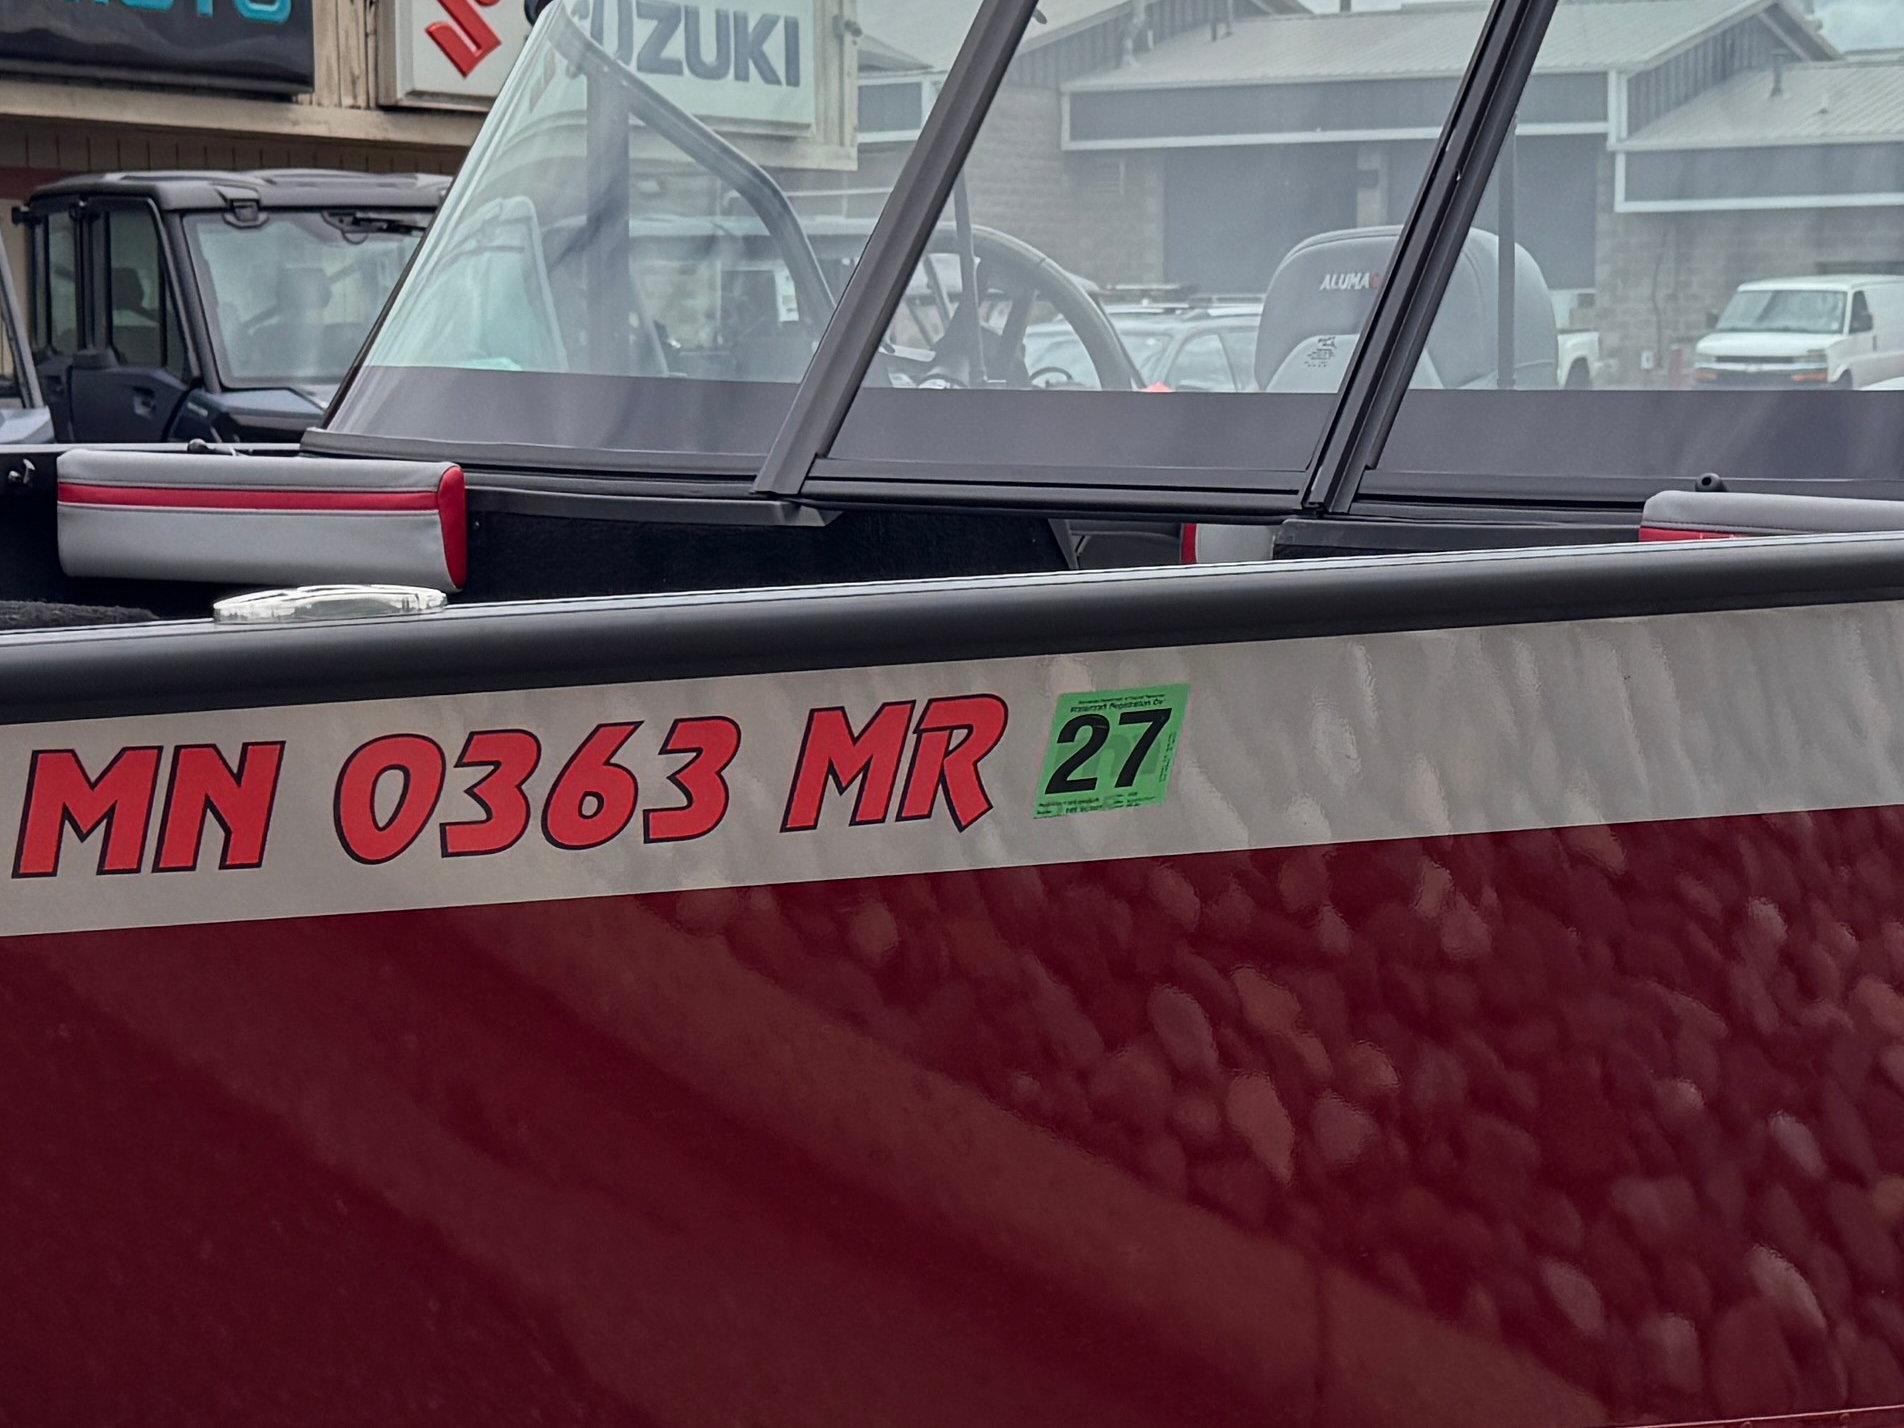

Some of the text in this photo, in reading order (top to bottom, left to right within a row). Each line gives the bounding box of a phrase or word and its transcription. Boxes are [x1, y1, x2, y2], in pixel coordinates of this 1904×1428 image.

[11, 693, 1009, 878] MN 0363 MR
[1044, 707, 1173, 795] 27
